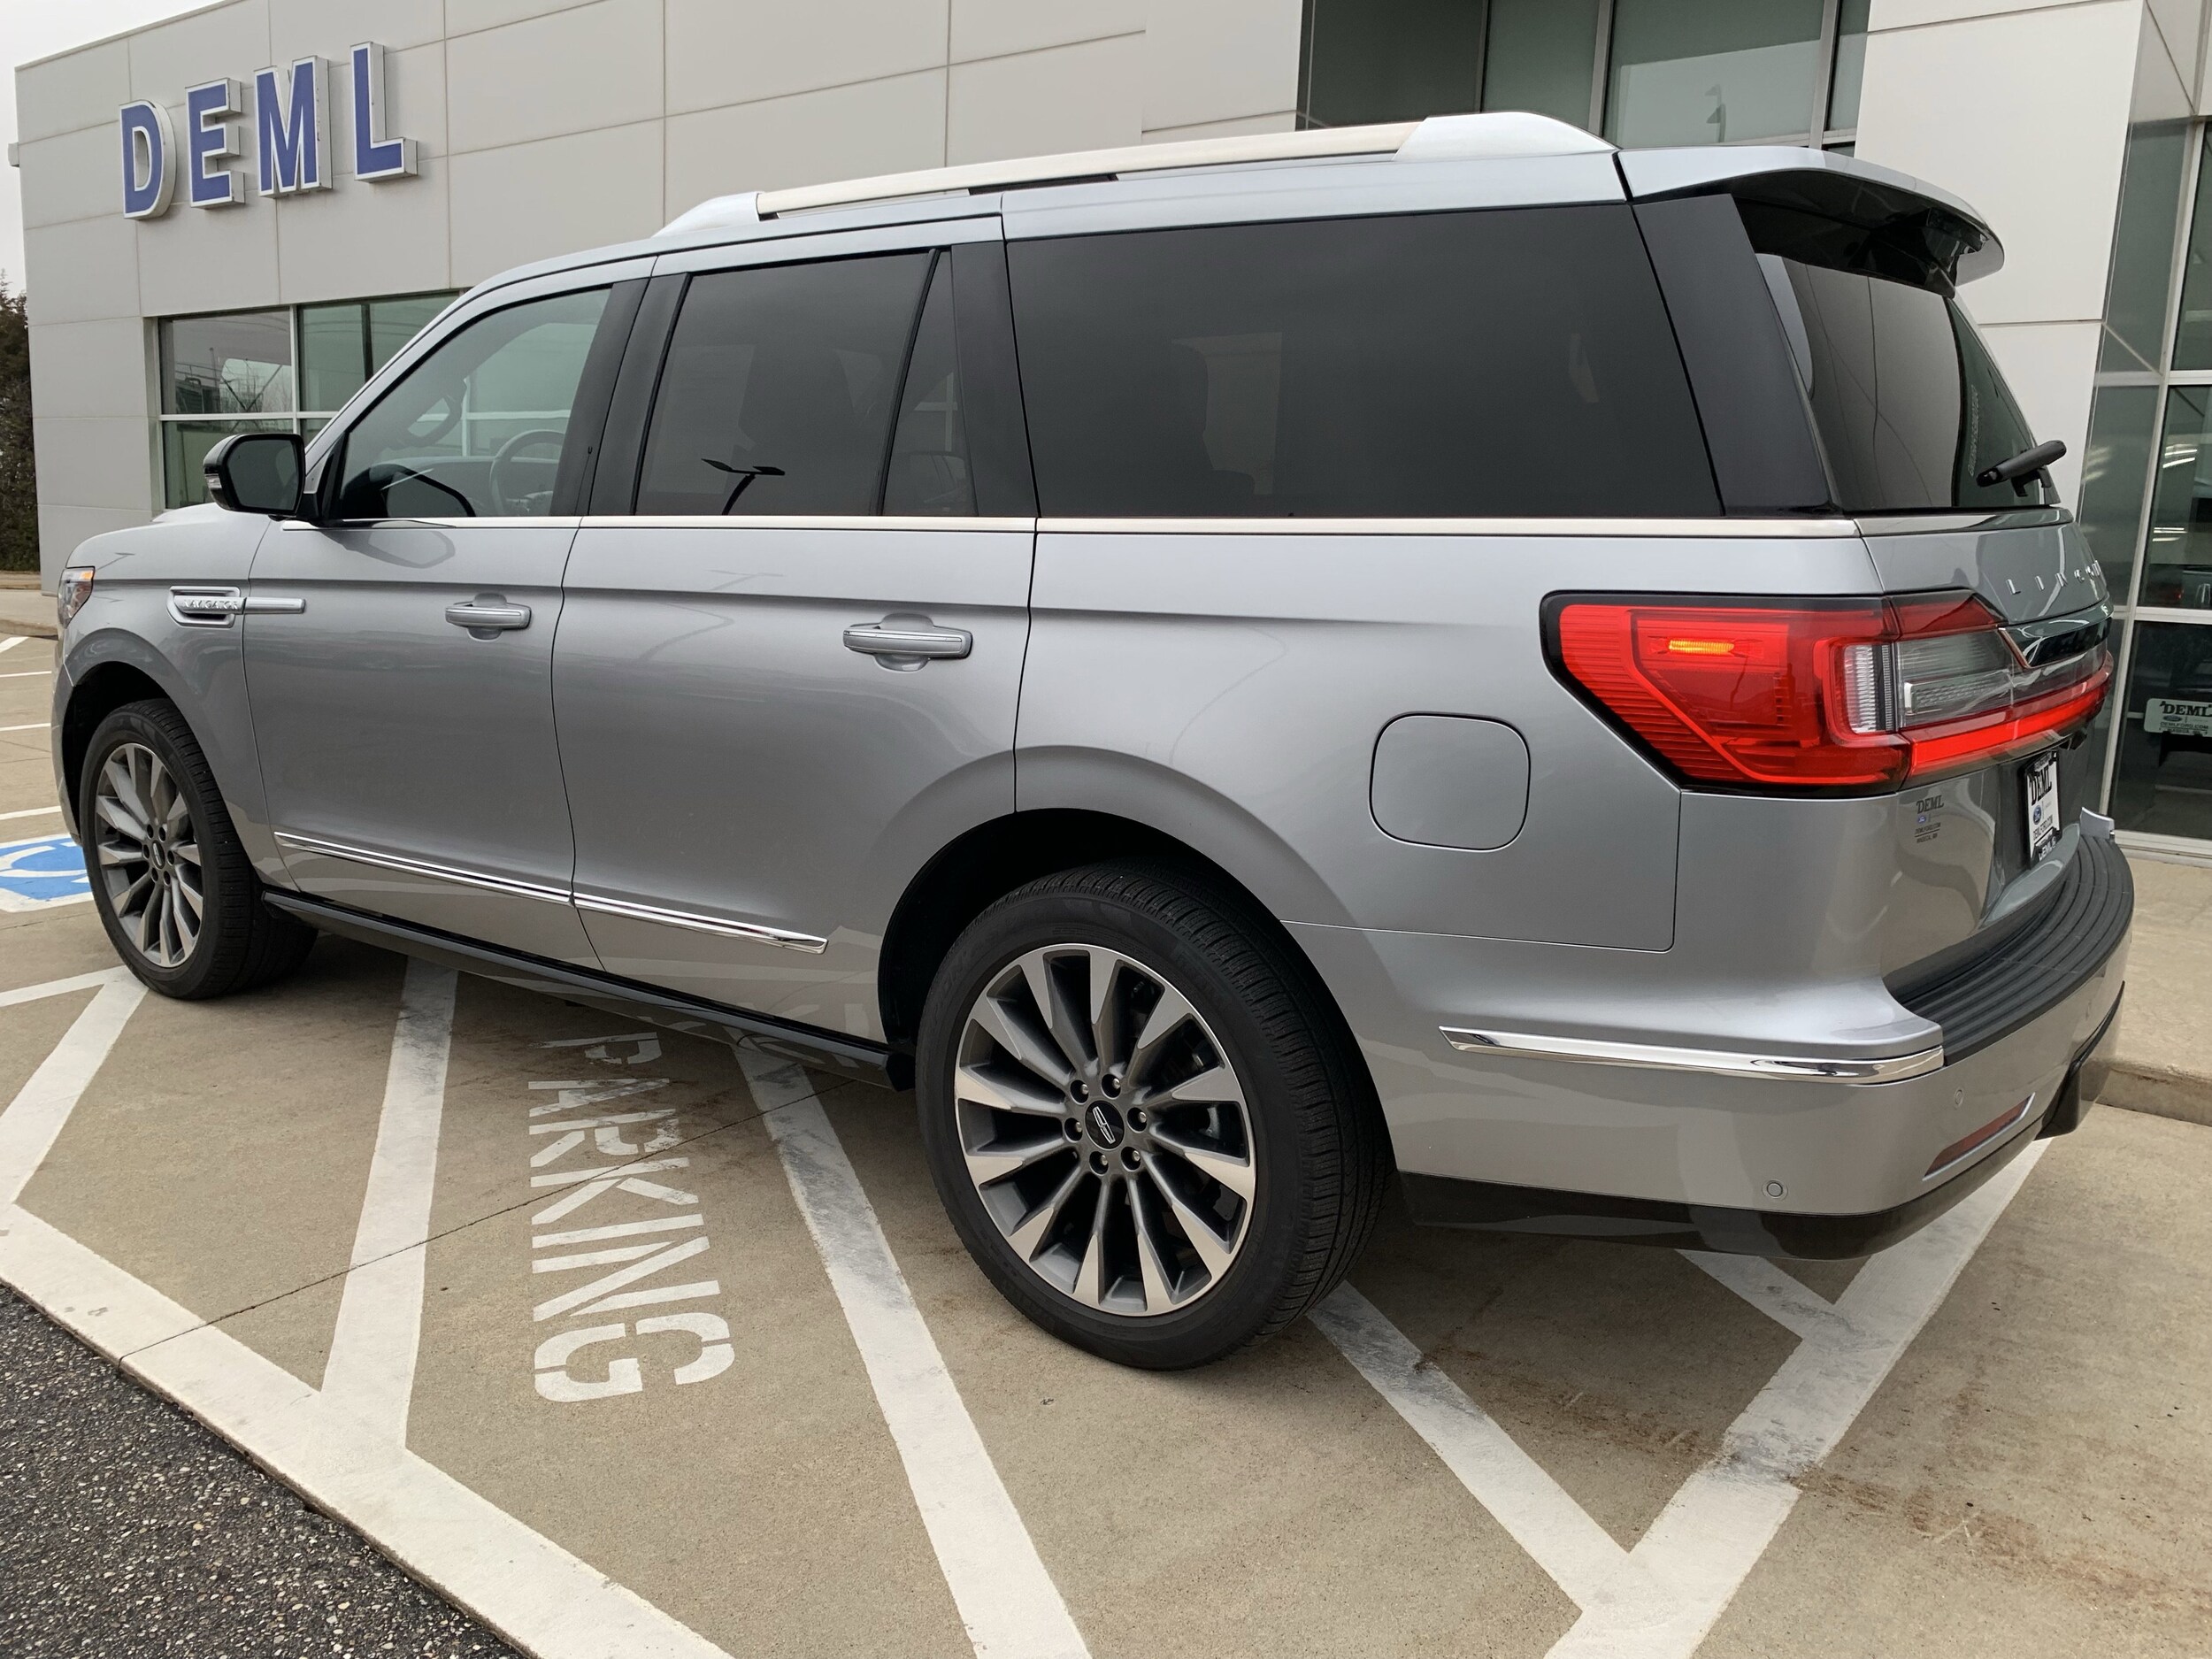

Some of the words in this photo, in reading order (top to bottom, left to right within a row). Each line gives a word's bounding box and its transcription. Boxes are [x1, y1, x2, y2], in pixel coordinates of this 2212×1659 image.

[119, 41, 418, 220] DEML
[1916, 795, 1945, 814] DEML
[2029, 764, 2053, 806] DEML
[527, 1032, 735, 1402] PARKING
